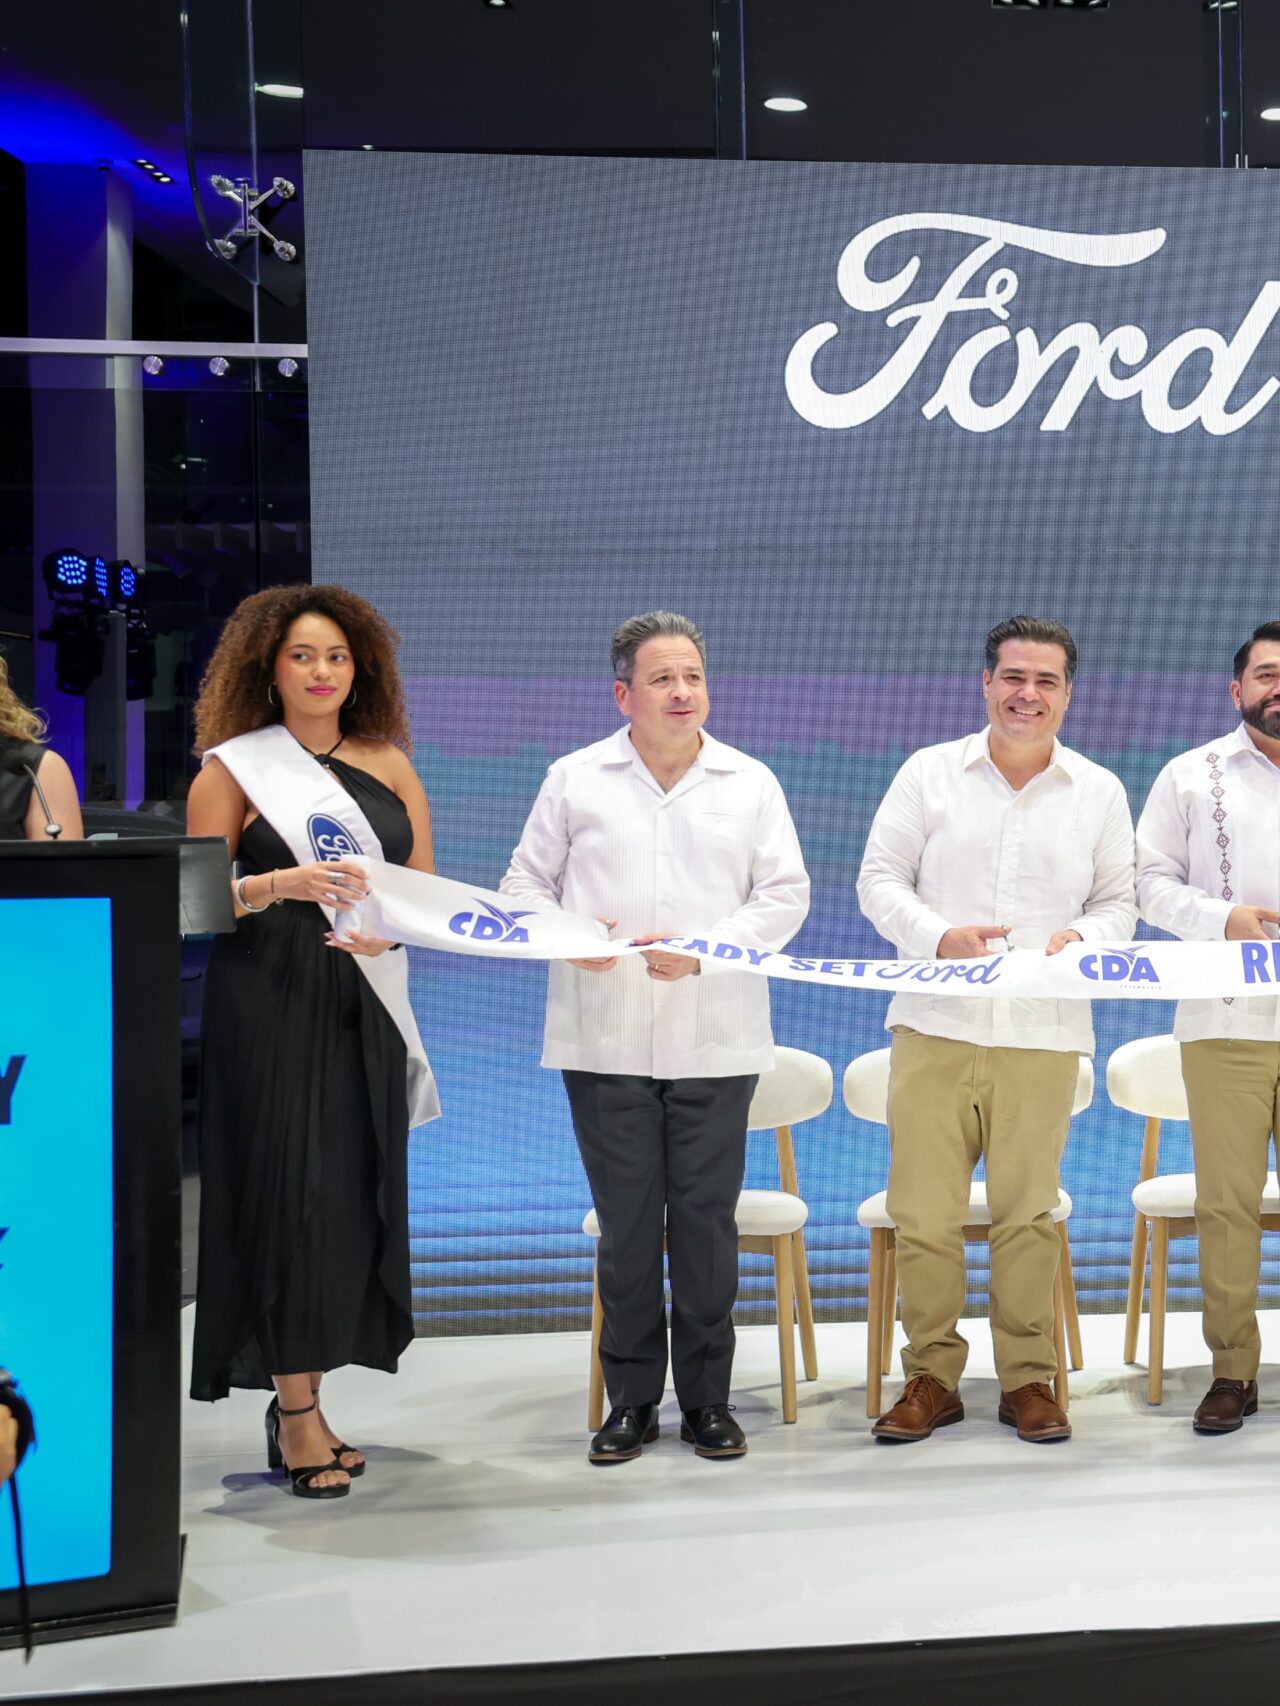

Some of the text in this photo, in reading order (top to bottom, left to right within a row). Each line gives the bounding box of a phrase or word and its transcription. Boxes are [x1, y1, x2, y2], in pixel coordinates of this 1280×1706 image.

[448, 911, 530, 943] CDA
[789, 959, 874, 977] SET
[1078, 954, 1161, 983] CDA
